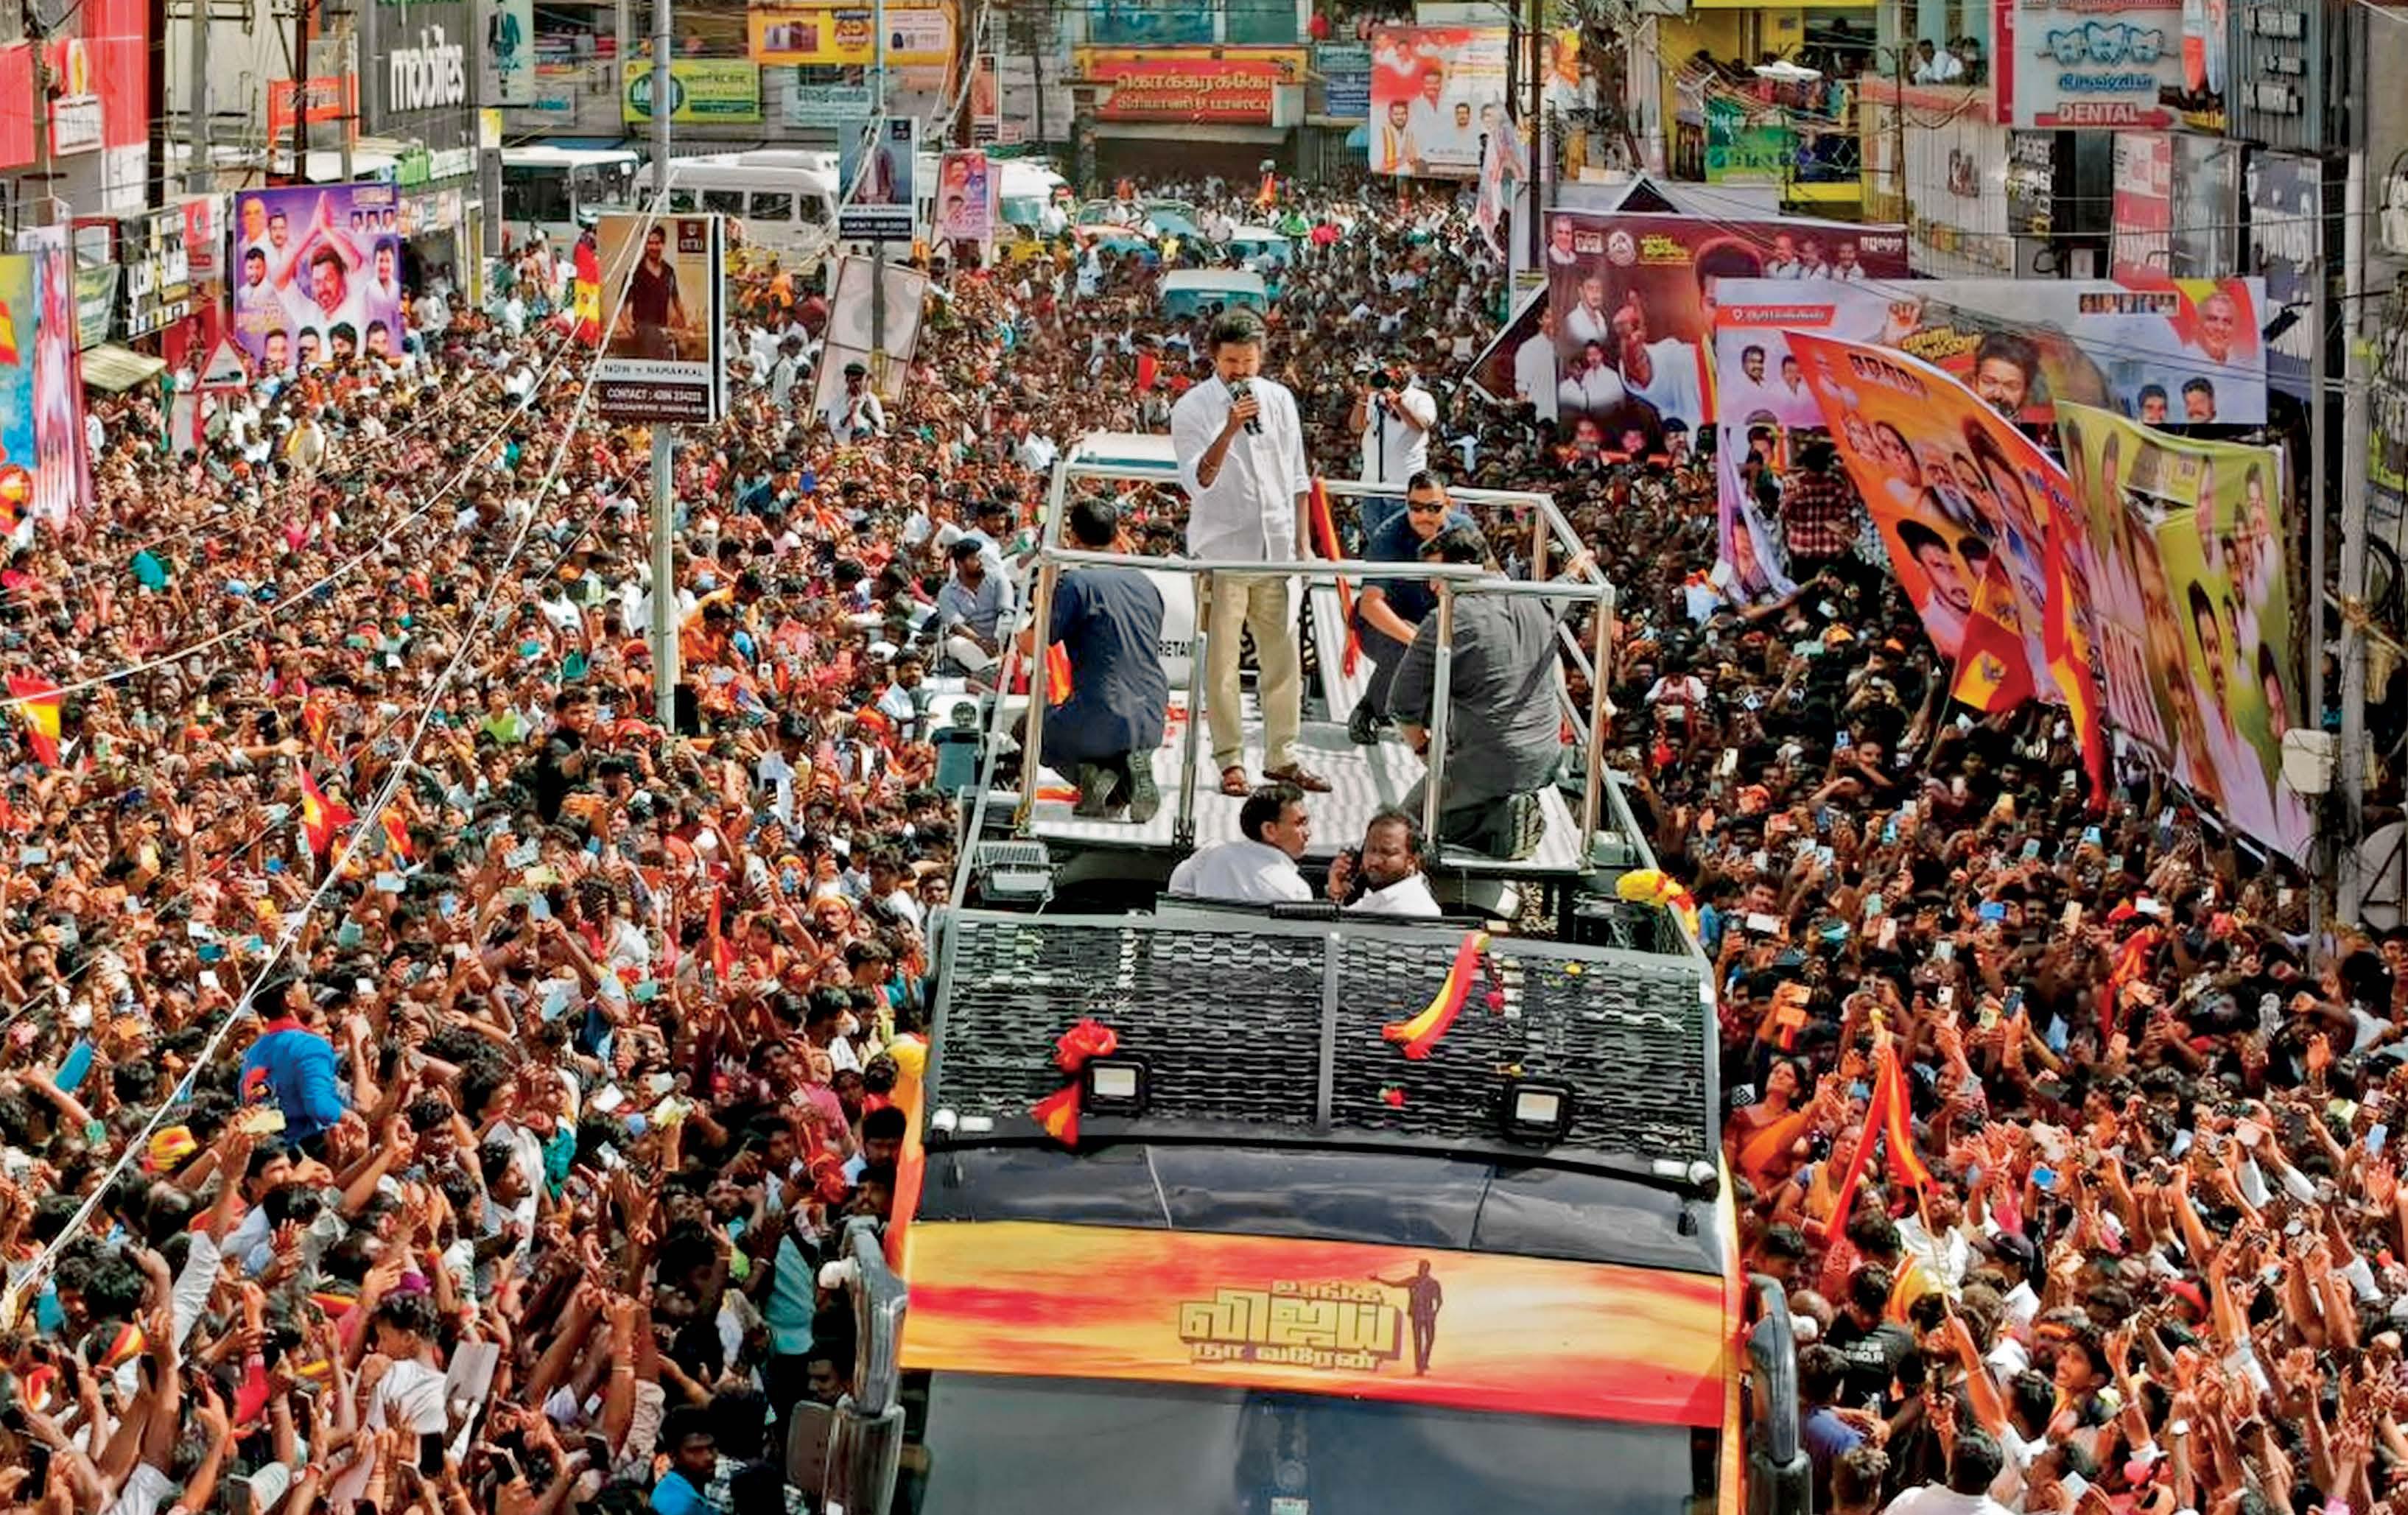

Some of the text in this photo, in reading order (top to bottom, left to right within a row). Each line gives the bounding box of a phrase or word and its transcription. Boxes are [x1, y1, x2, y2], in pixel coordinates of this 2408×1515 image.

[390, 24, 464, 111] mobiles
[2058, 102, 2140, 123] DENTAL
[1158, 640, 1191, 657] RETA
